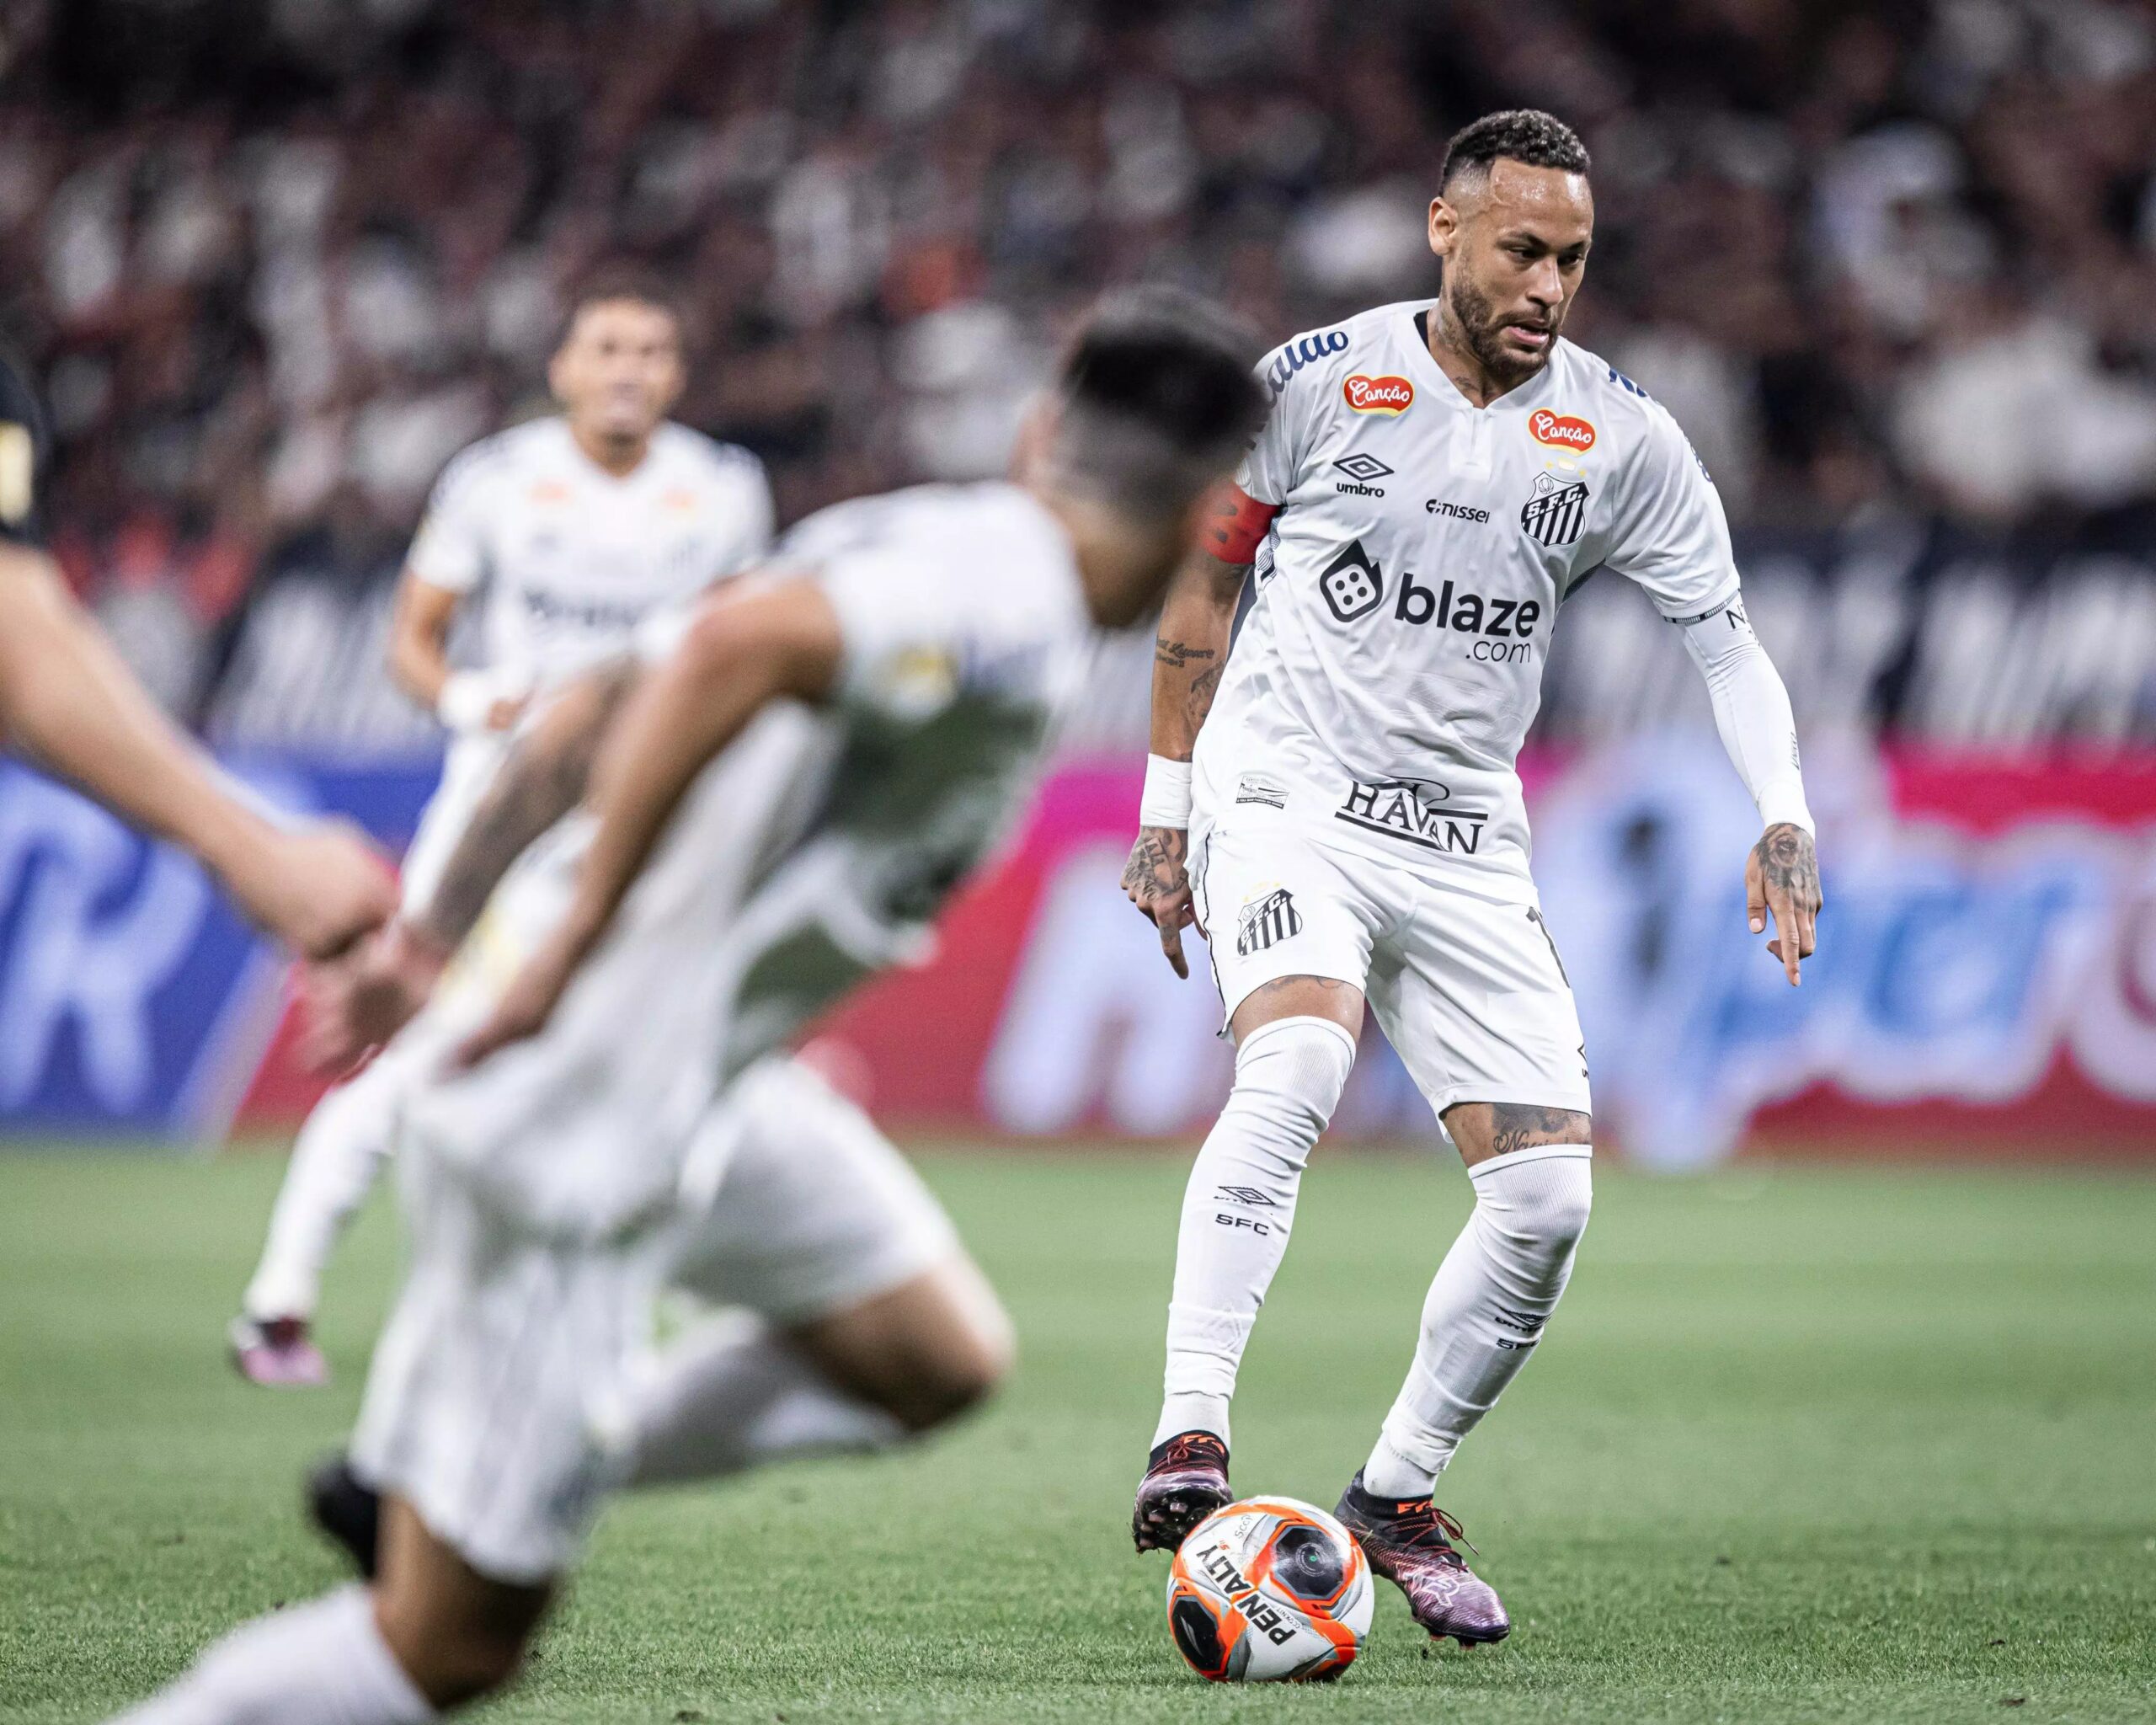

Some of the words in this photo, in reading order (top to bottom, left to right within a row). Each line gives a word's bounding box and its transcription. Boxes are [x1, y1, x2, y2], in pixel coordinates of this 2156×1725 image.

[1349, 380, 1410, 406] Canção
[1535, 414, 1592, 444] Canção
[1337, 482, 1385, 499] umbro
[1395, 572, 1540, 638] blaze
[1465, 640, 1532, 664] .com
[1341, 777, 1484, 855] HAVAN
[1215, 1213, 1269, 1236] SFC
[1196, 1545, 1297, 1646] PENALTY
